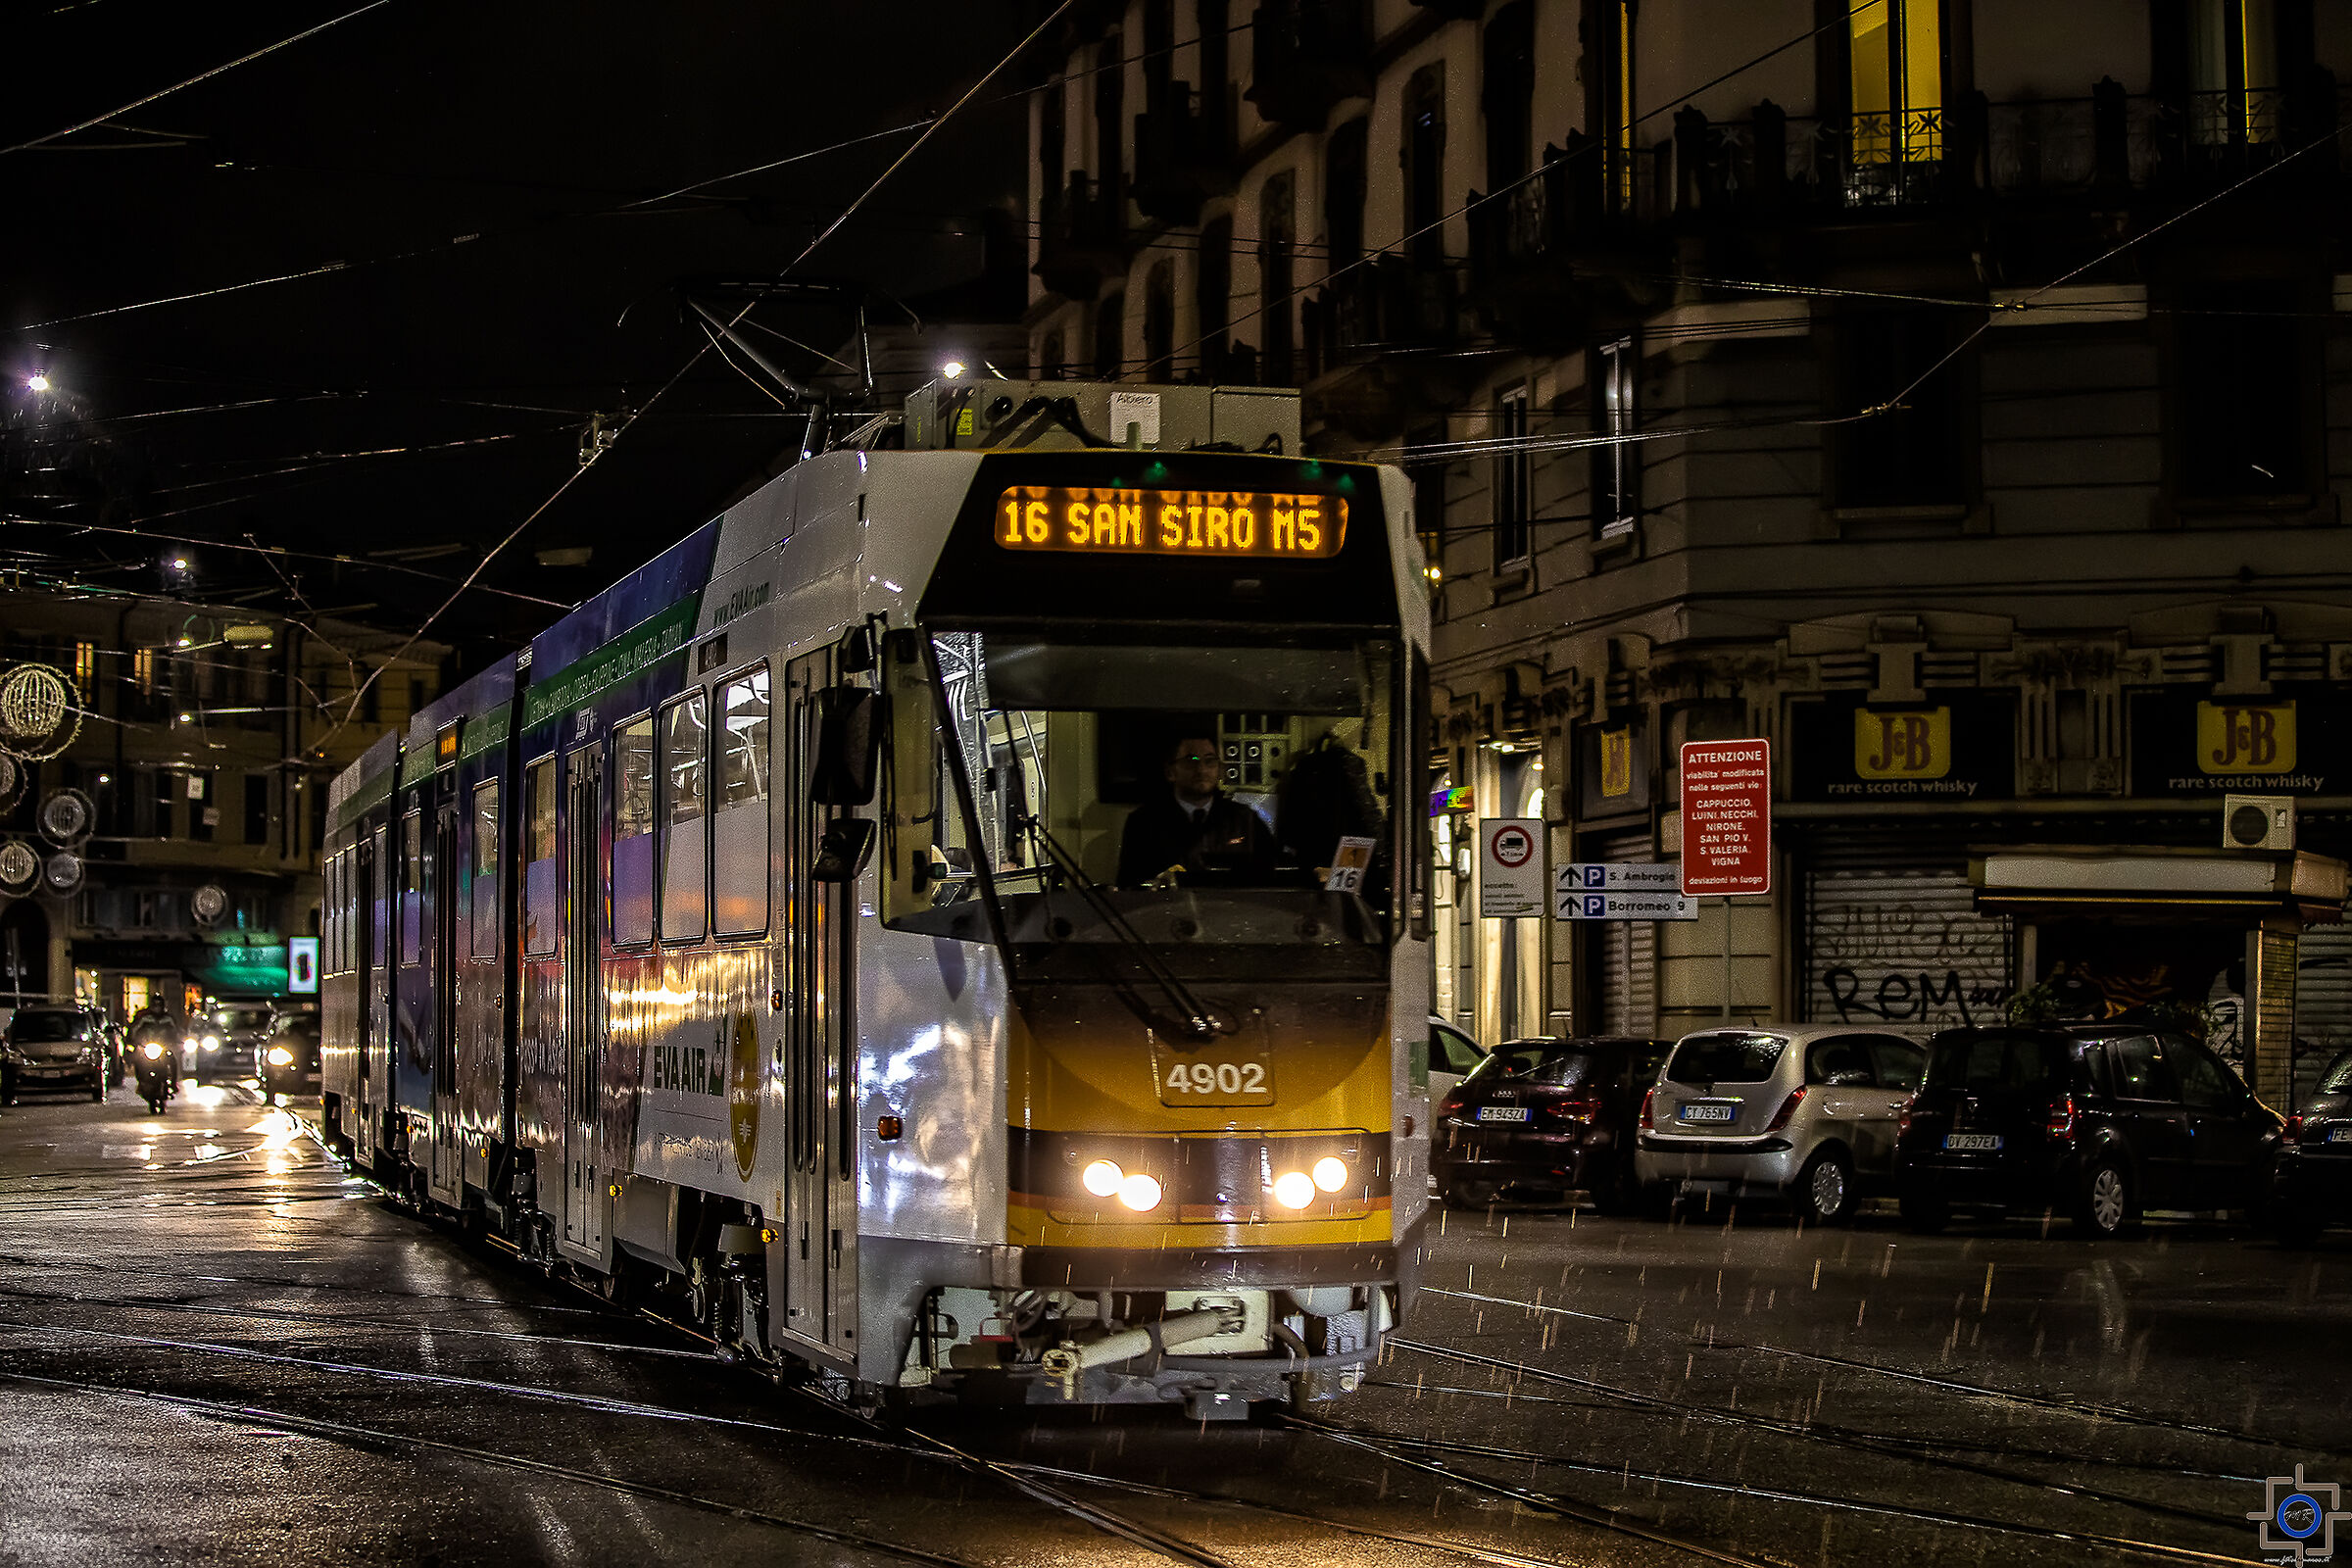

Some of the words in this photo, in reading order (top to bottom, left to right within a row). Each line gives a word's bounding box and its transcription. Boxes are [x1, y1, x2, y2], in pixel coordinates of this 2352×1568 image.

[1004, 501, 1048, 543] 16
[1067, 502, 1143, 545] SAN
[1161, 505, 1253, 549] SIRO
[1273, 508, 1320, 551] M5
[1869, 715, 1932, 772] J&B
[2212, 709, 2277, 766] J&B
[1689, 751, 1762, 764] ATTENZIONE
[1722, 768, 1765, 778] modificata
[1710, 781, 1745, 793] seguenti
[1828, 782, 1864, 795] rare
[1866, 780, 1919, 795] scotch
[1921, 779, 1978, 798] whisky
[2169, 777, 2204, 790] rare
[2208, 774, 2261, 790] scotch
[2265, 773, 2325, 793] whisky
[1699, 834, 1720, 844] SAN
[1724, 833, 1740, 843] PIO
[1710, 857, 1740, 867] VIGNA
[1336, 869, 1357, 889] 16
[1588, 868, 1601, 885] P
[1624, 871, 1676, 882] Ambrogio
[1689, 875, 1729, 885] deviazioni
[1730, 875, 1738, 884] in
[1588, 898, 1601, 914] P
[1608, 901, 1671, 911] Borromeo
[654, 1045, 680, 1091] EVA
[681, 1046, 706, 1094] AIR
[1166, 1062, 1267, 1094] 4902
